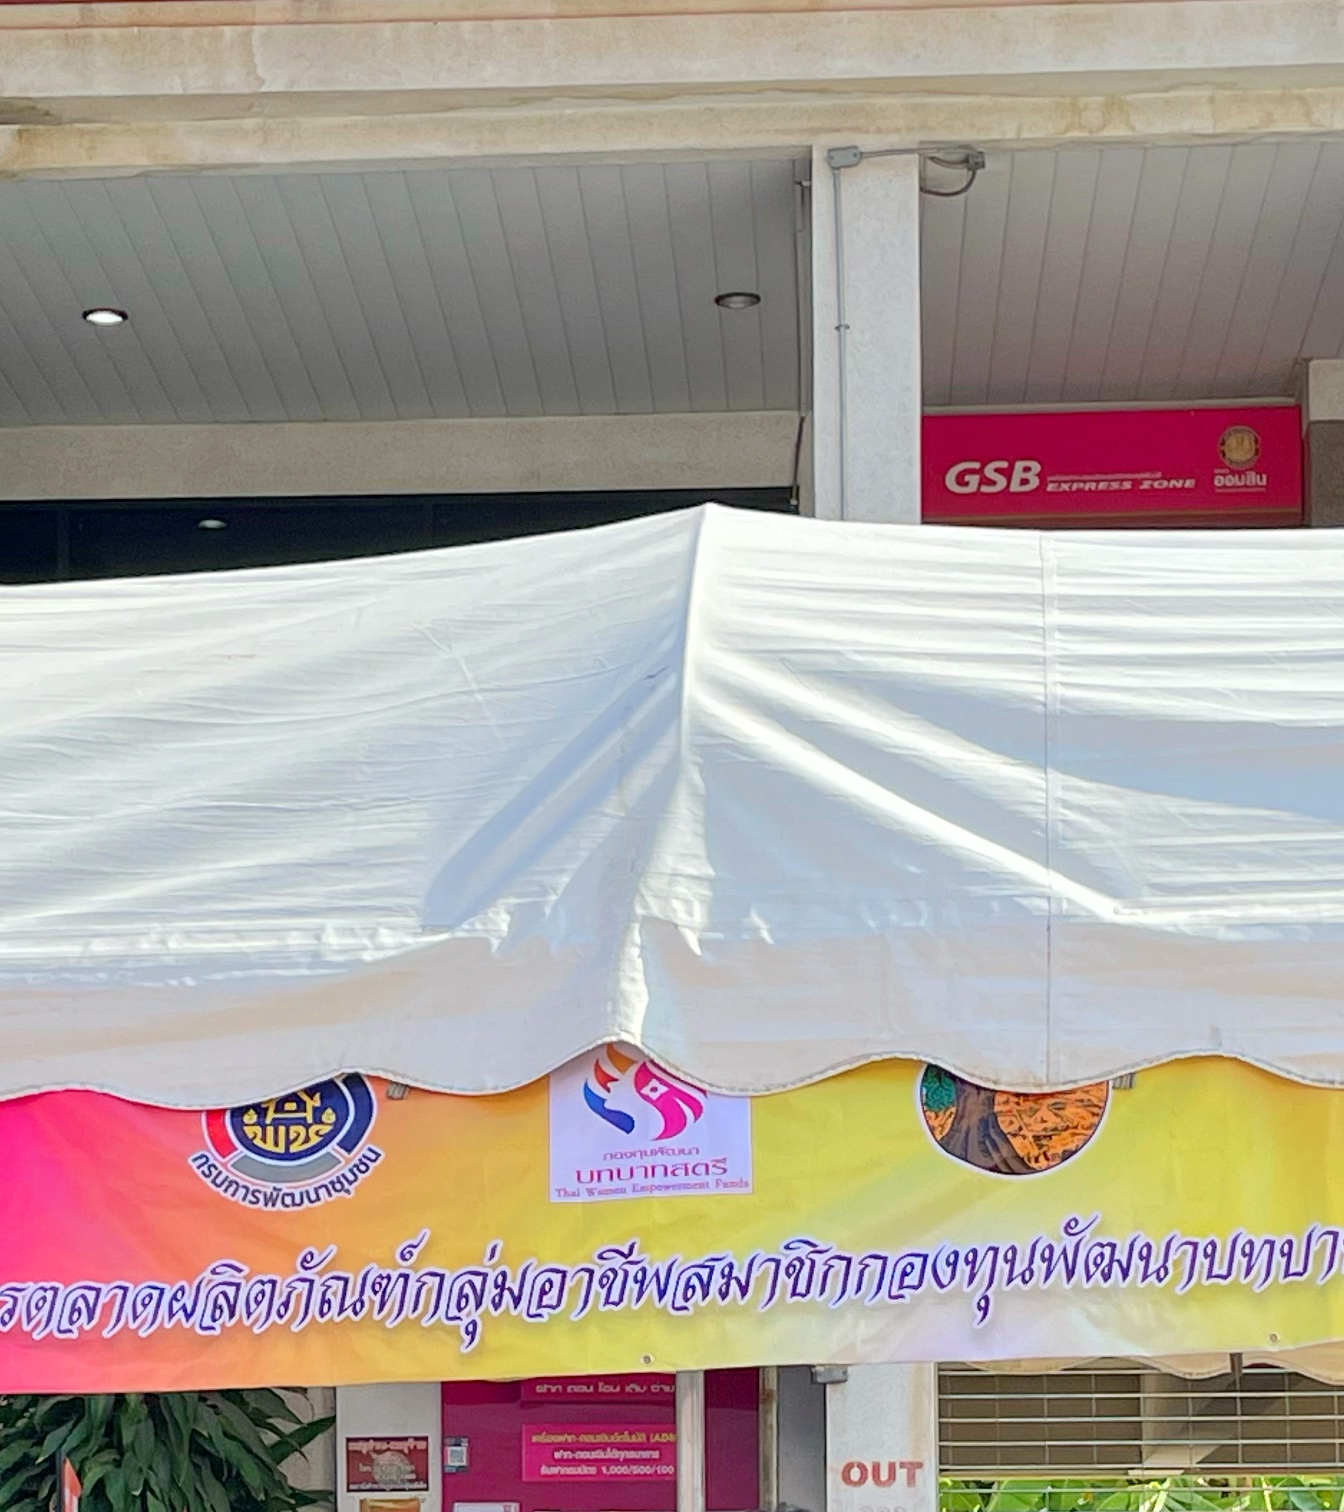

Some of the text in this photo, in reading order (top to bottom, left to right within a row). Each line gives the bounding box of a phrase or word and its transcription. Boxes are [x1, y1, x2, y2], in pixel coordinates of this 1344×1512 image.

[944, 459, 1043, 494] GSB
[1045, 478, 1197, 493] EXPRESS ZONE
[190, 1146, 383, 1209] กรมการพัฒนาชุมชน
[575, 1157, 728, 1185] บทบาทสตรี
[555, 1187, 581, 1199] Thai
[585, 1185, 627, 1198] Women
[714, 1177, 750, 1190] Funds
[840, 1460, 924, 1488] OUT
